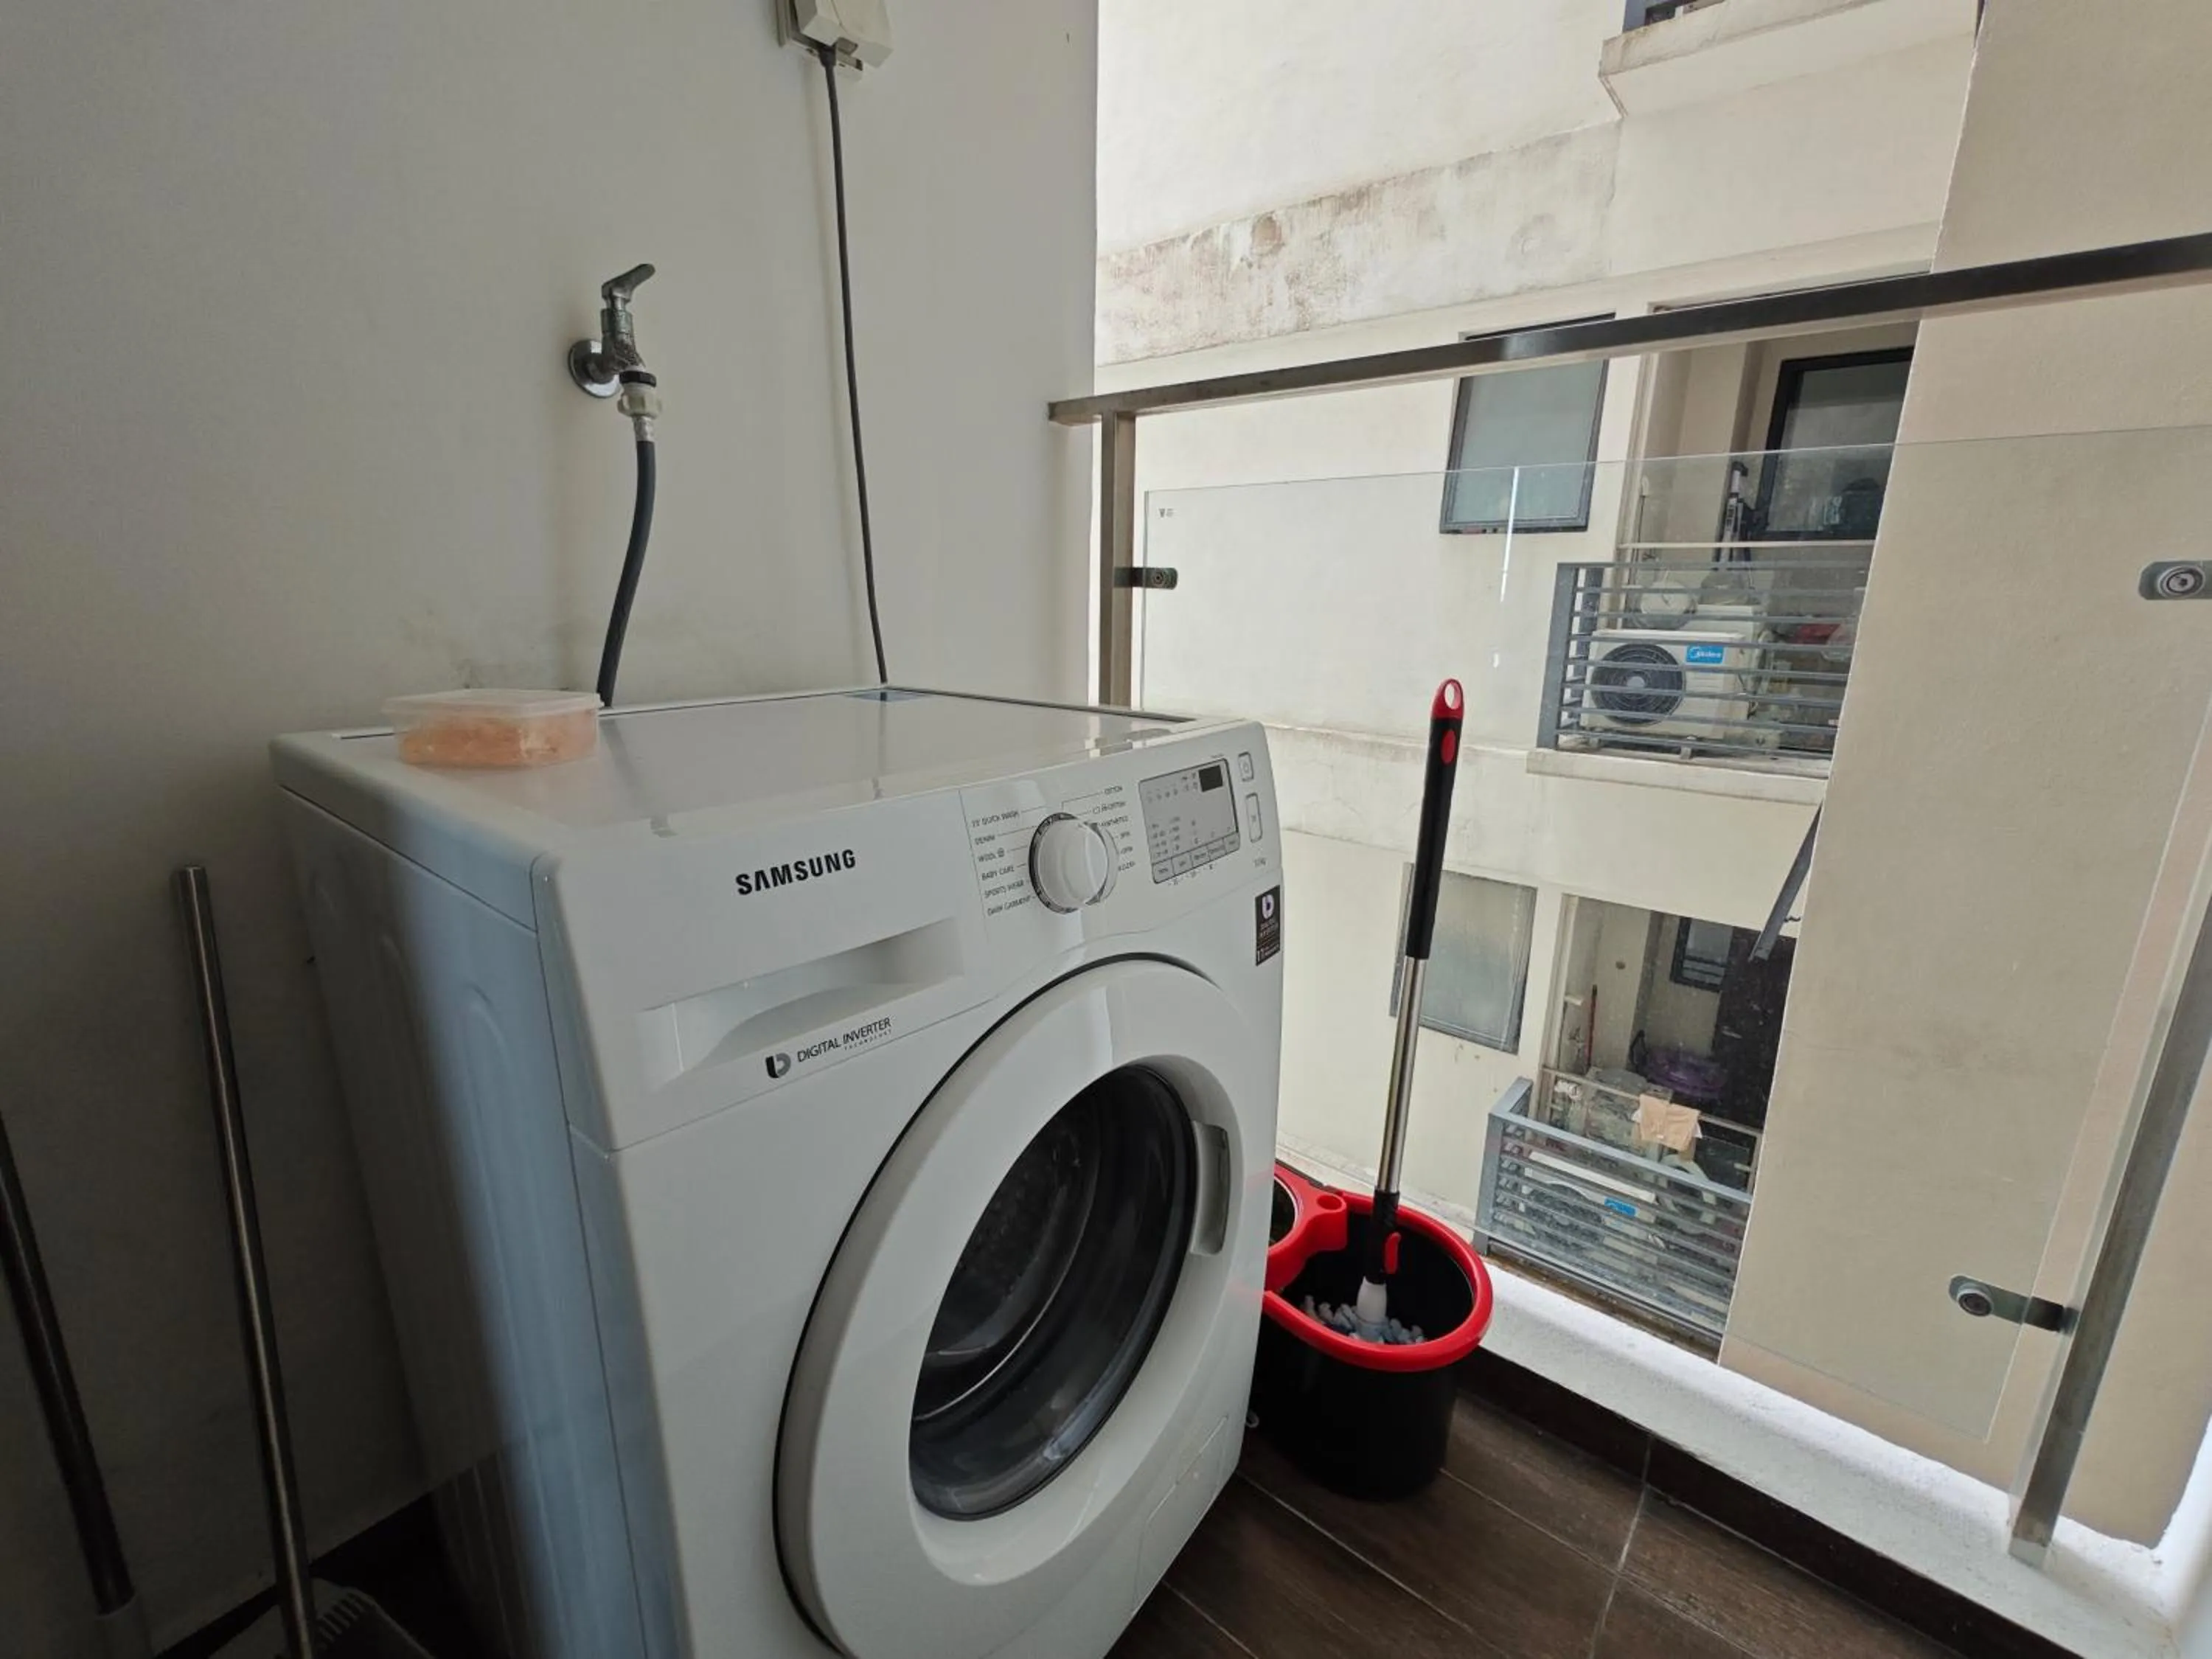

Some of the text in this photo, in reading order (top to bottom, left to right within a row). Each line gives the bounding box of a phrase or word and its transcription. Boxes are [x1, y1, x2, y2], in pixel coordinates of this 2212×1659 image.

[736, 849, 856, 895] SAMSUNG
[797, 1017, 891, 1062] DIGITAL INVERTER
